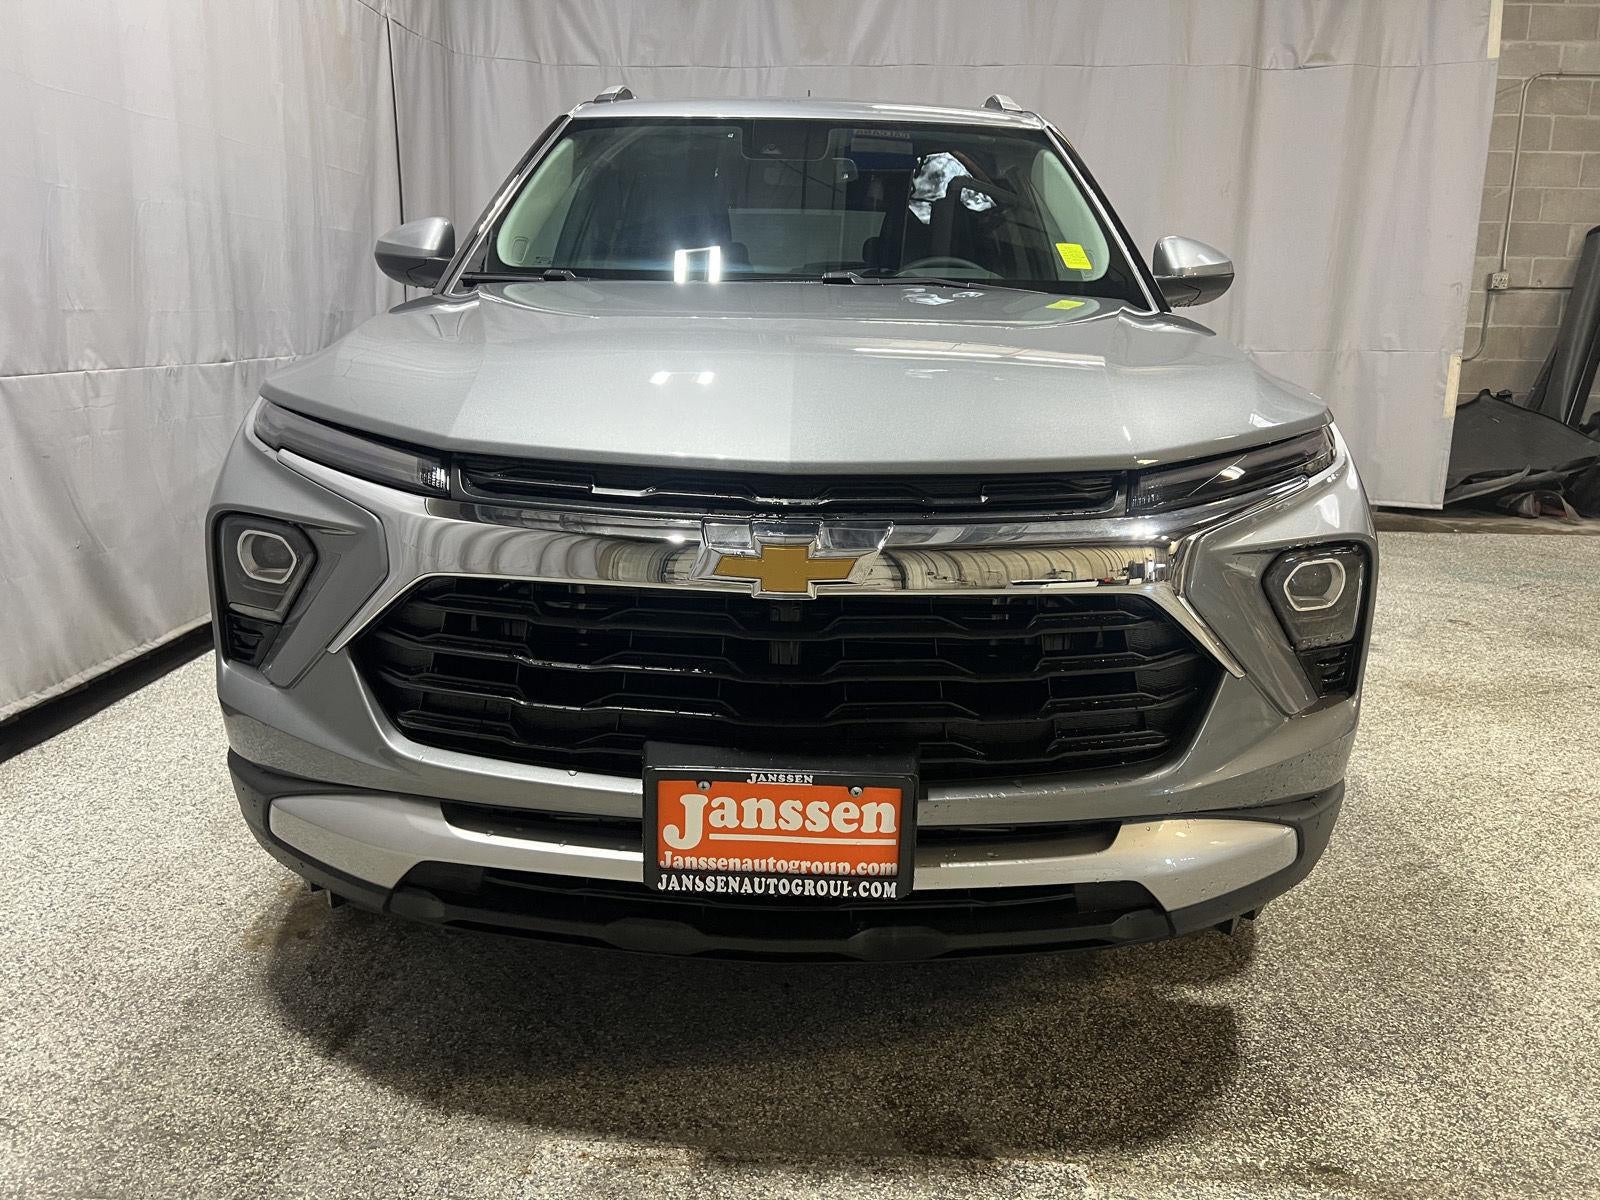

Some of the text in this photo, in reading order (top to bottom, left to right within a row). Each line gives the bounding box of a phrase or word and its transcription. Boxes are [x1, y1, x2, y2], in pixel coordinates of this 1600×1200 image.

[747, 773, 813, 784] JANSSEN
[663, 795, 896, 850] Janssen
[660, 851, 897, 875] Janssenautogroup.com
